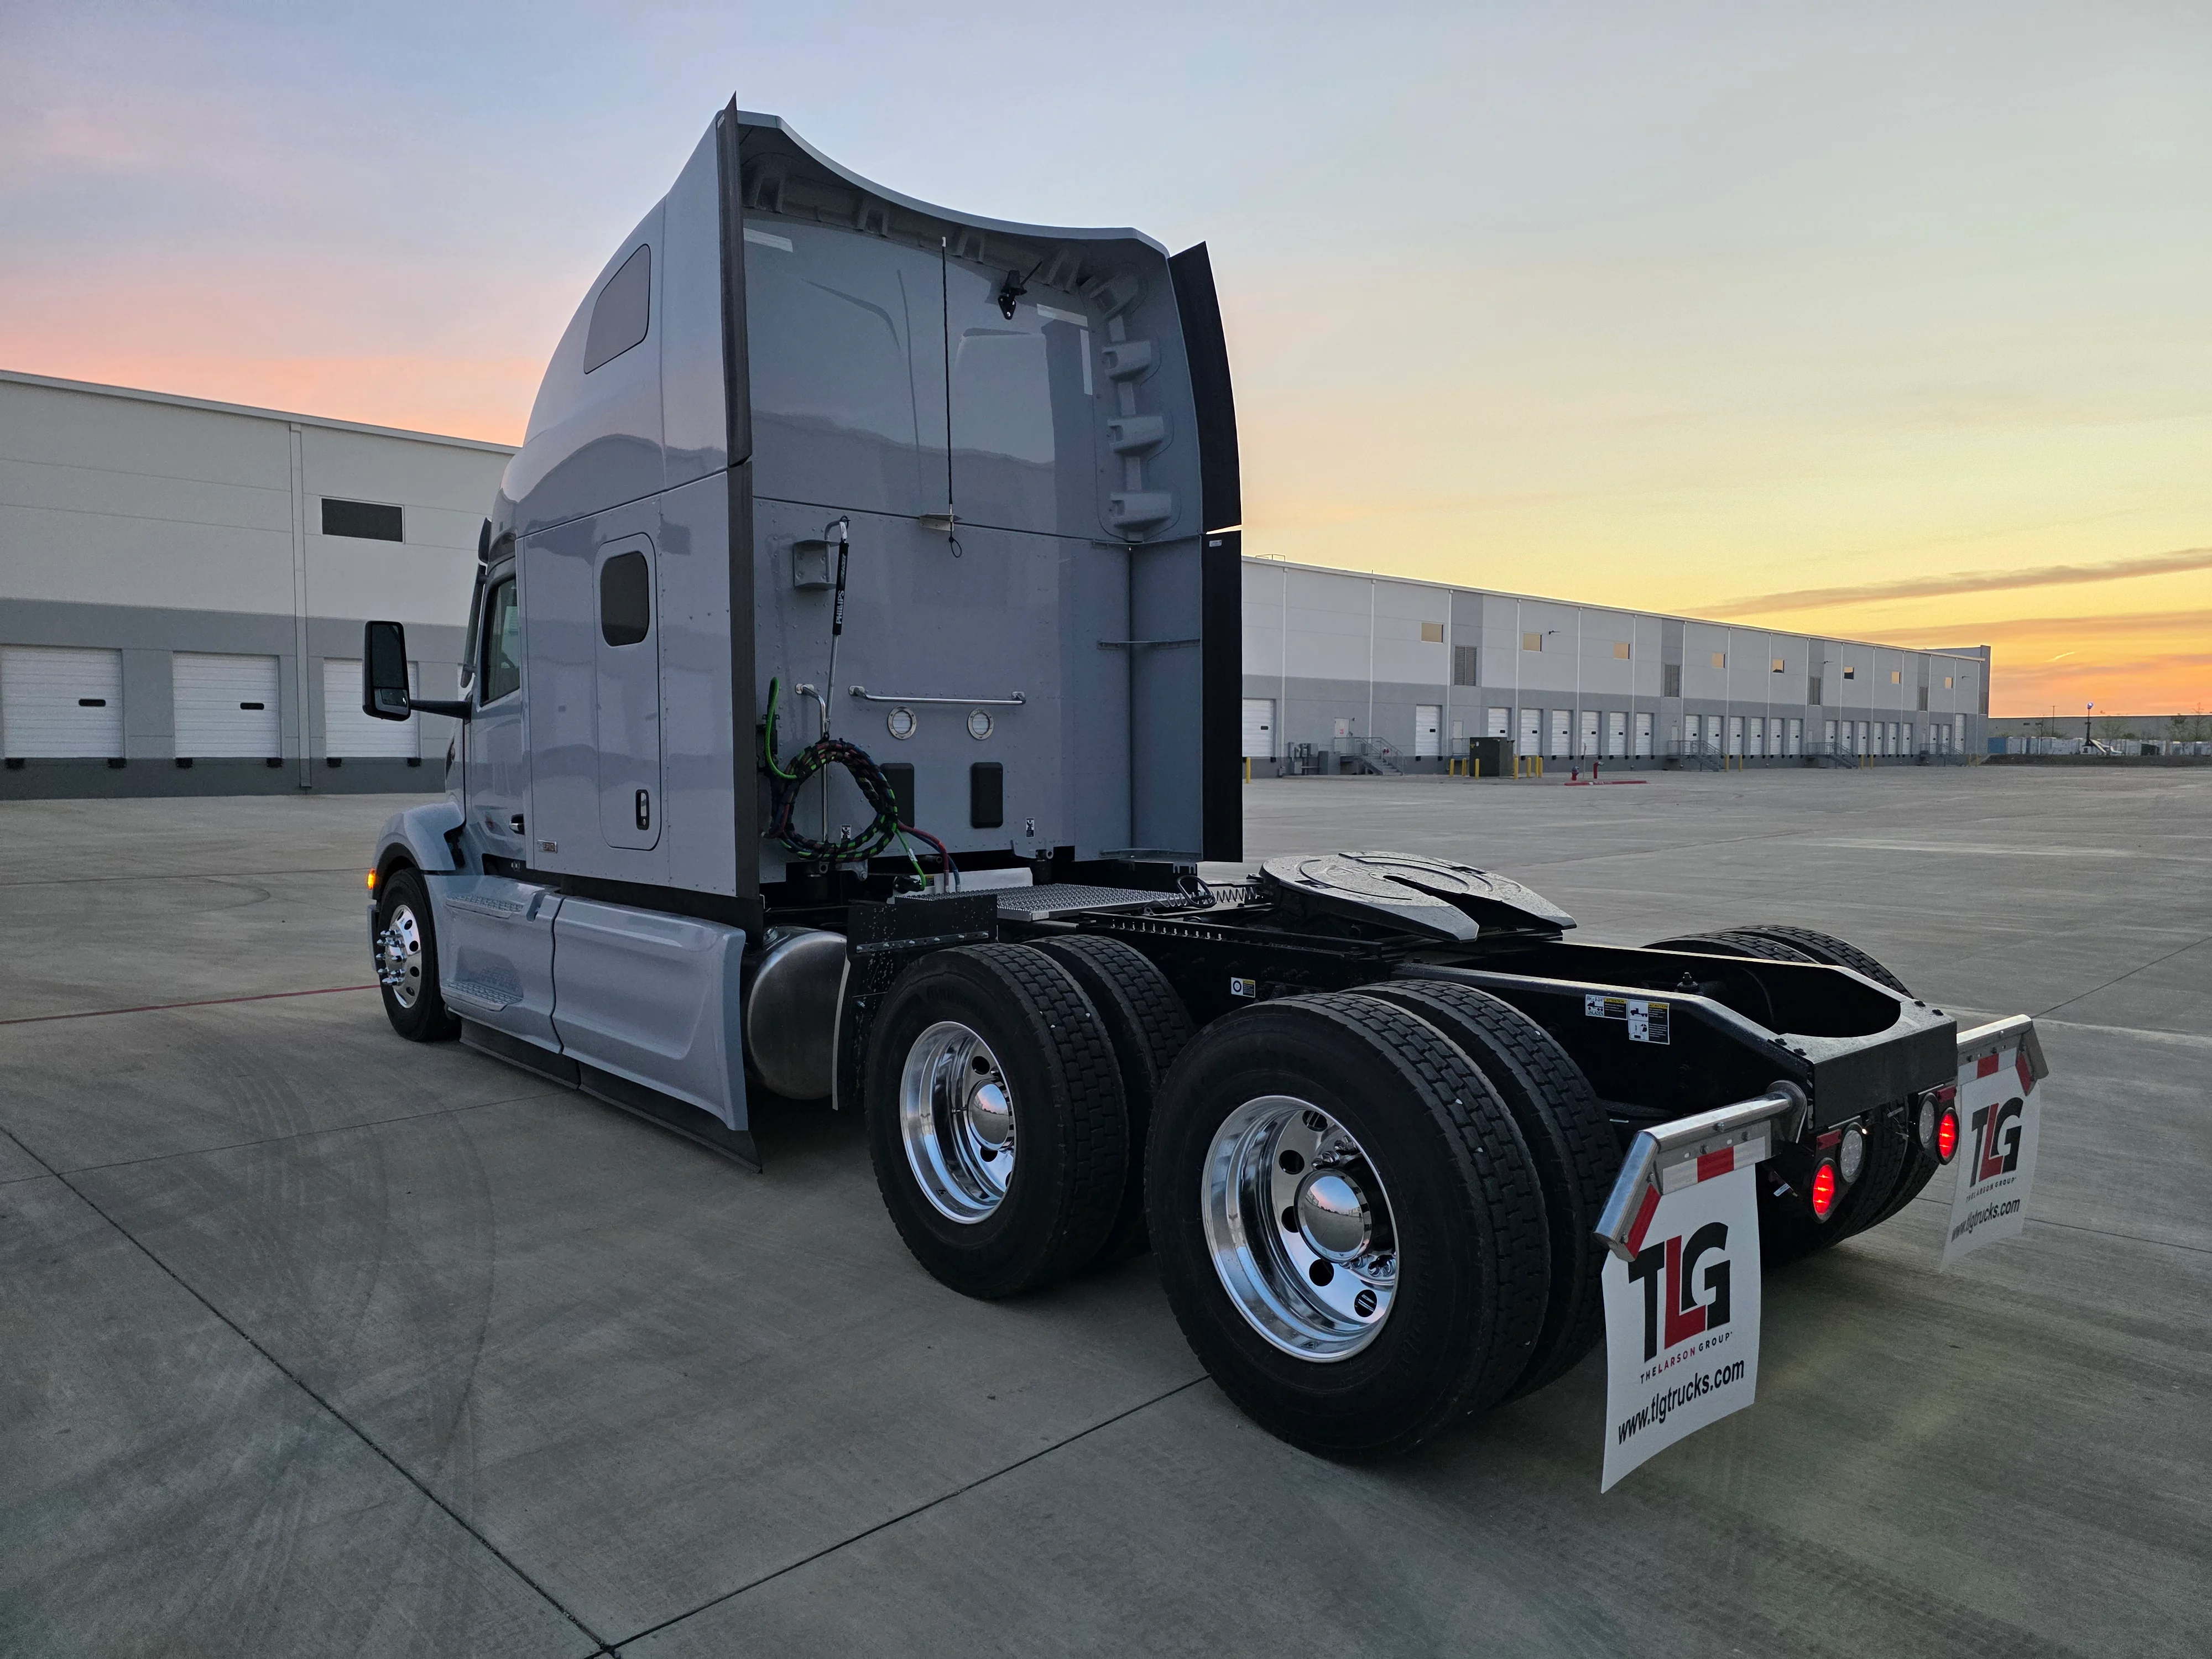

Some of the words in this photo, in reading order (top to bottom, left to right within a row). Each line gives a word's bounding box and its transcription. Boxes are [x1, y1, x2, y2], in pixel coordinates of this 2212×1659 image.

[1970, 1097, 2023, 1187] TLG
[1995, 1177, 2015, 1187] GROUP
[1950, 1198, 2020, 1243] www.tlgtrucks.com
[1627, 1222, 1730, 1363] TLG
[1699, 1333, 1730, 1352] GROUP
[1618, 1360, 1745, 1445] www.tlgtrucks.com
